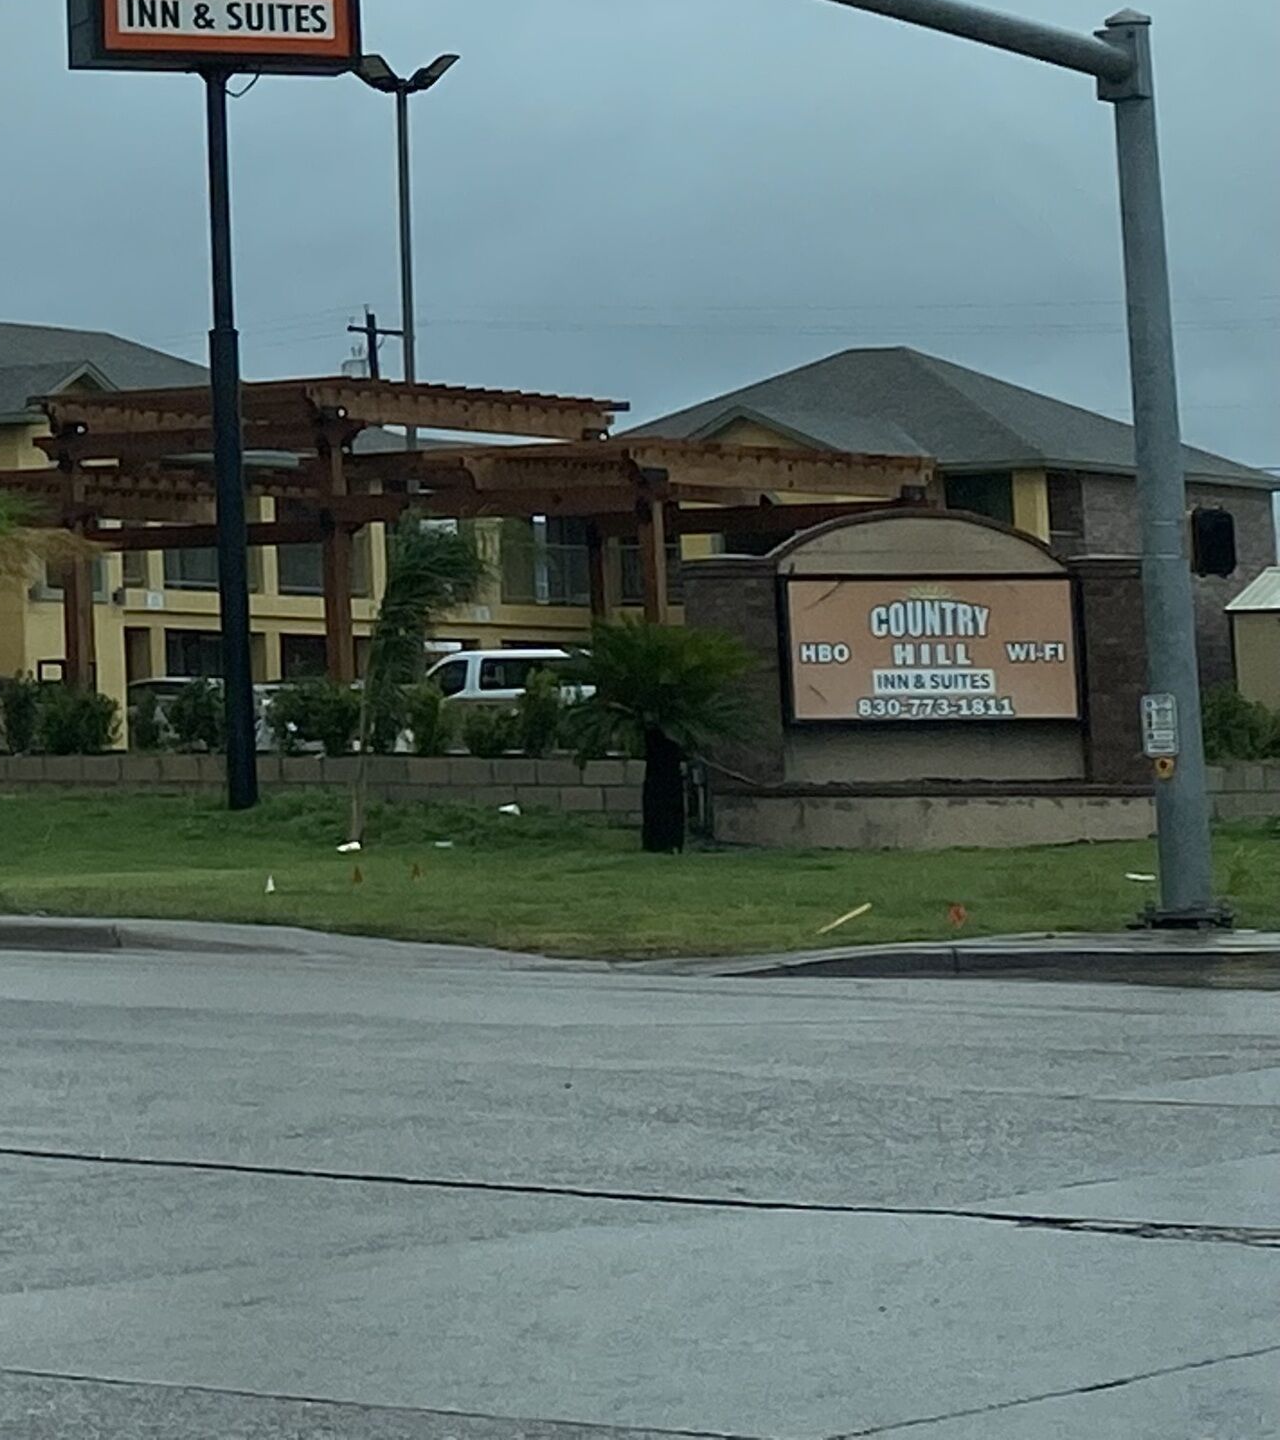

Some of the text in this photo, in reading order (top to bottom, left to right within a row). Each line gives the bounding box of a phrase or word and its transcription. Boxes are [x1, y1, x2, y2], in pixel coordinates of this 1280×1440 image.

[193, 3, 215, 28] &
[226, 2, 327, 32] SUITES
[870, 600, 989, 637] COUNTRY
[800, 643, 851, 663] HBO
[893, 643, 972, 666] HILL
[1006, 643, 1065, 662] WI-FI
[877, 673, 990, 690] INN & SUITES
[857, 698, 1015, 716] 830-773-1811
